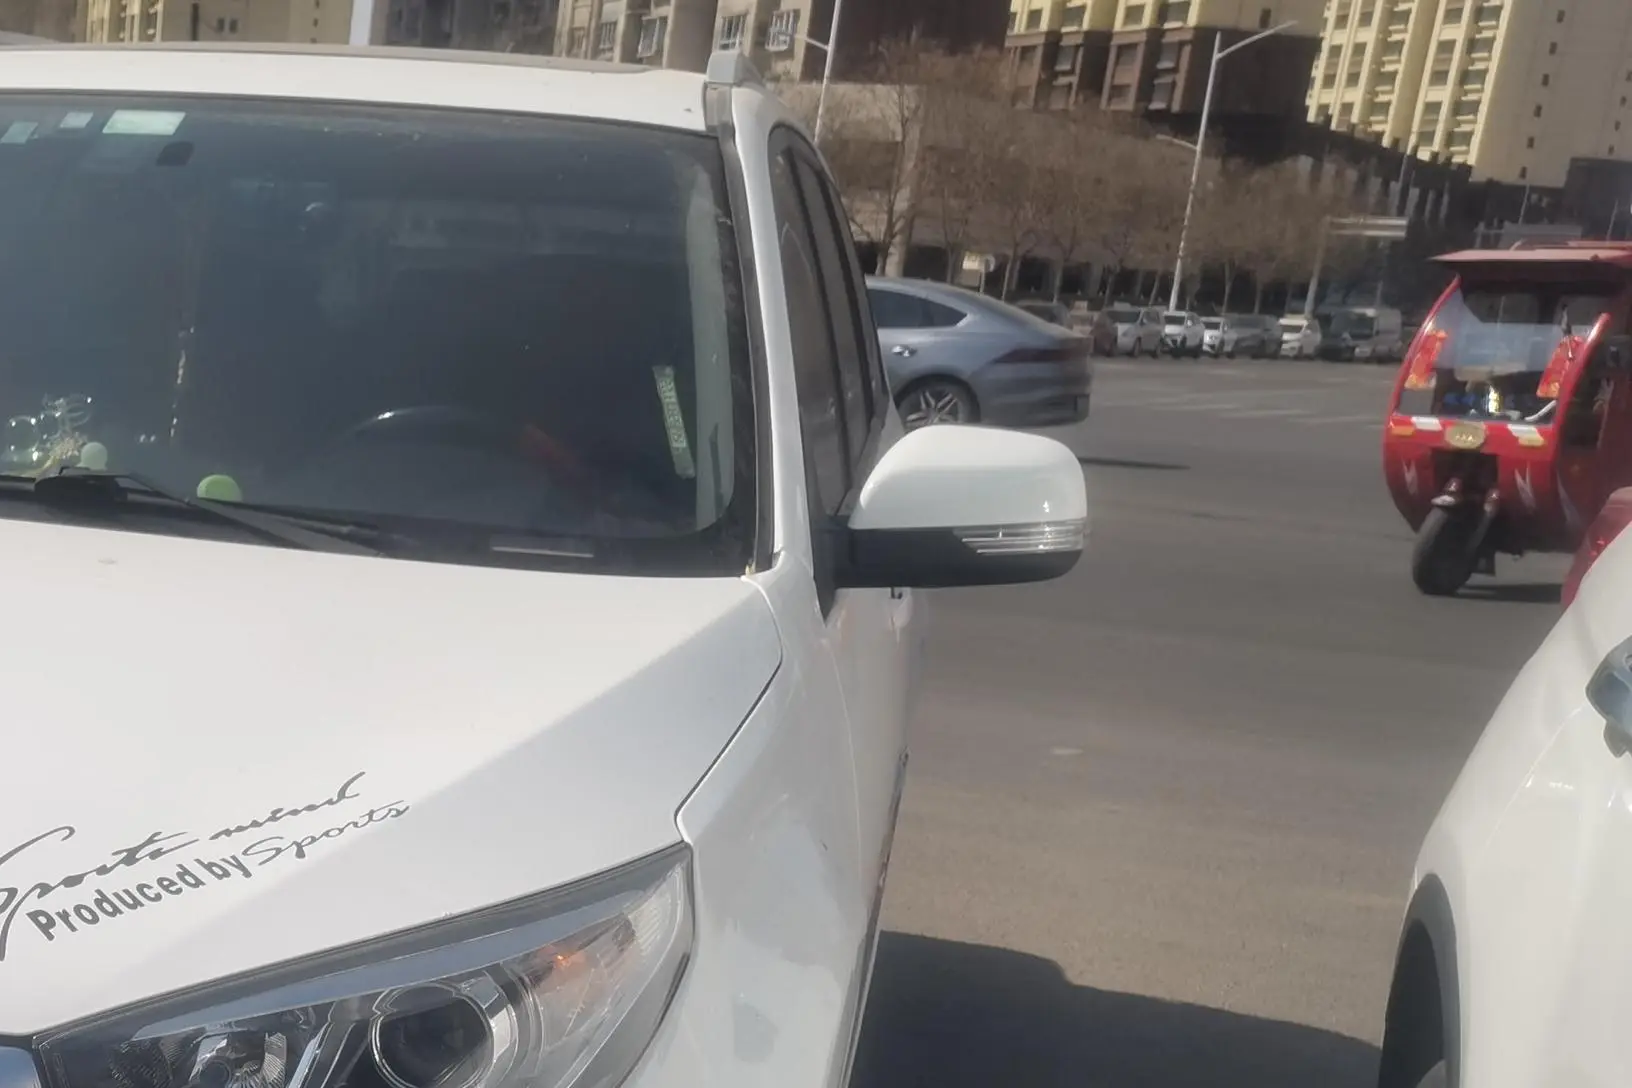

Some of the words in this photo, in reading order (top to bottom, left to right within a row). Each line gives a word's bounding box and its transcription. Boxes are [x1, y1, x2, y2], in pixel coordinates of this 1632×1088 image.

[25, 863, 207, 942] Produced
[193, 854, 253, 880] by
[241, 799, 410, 866] Sports
